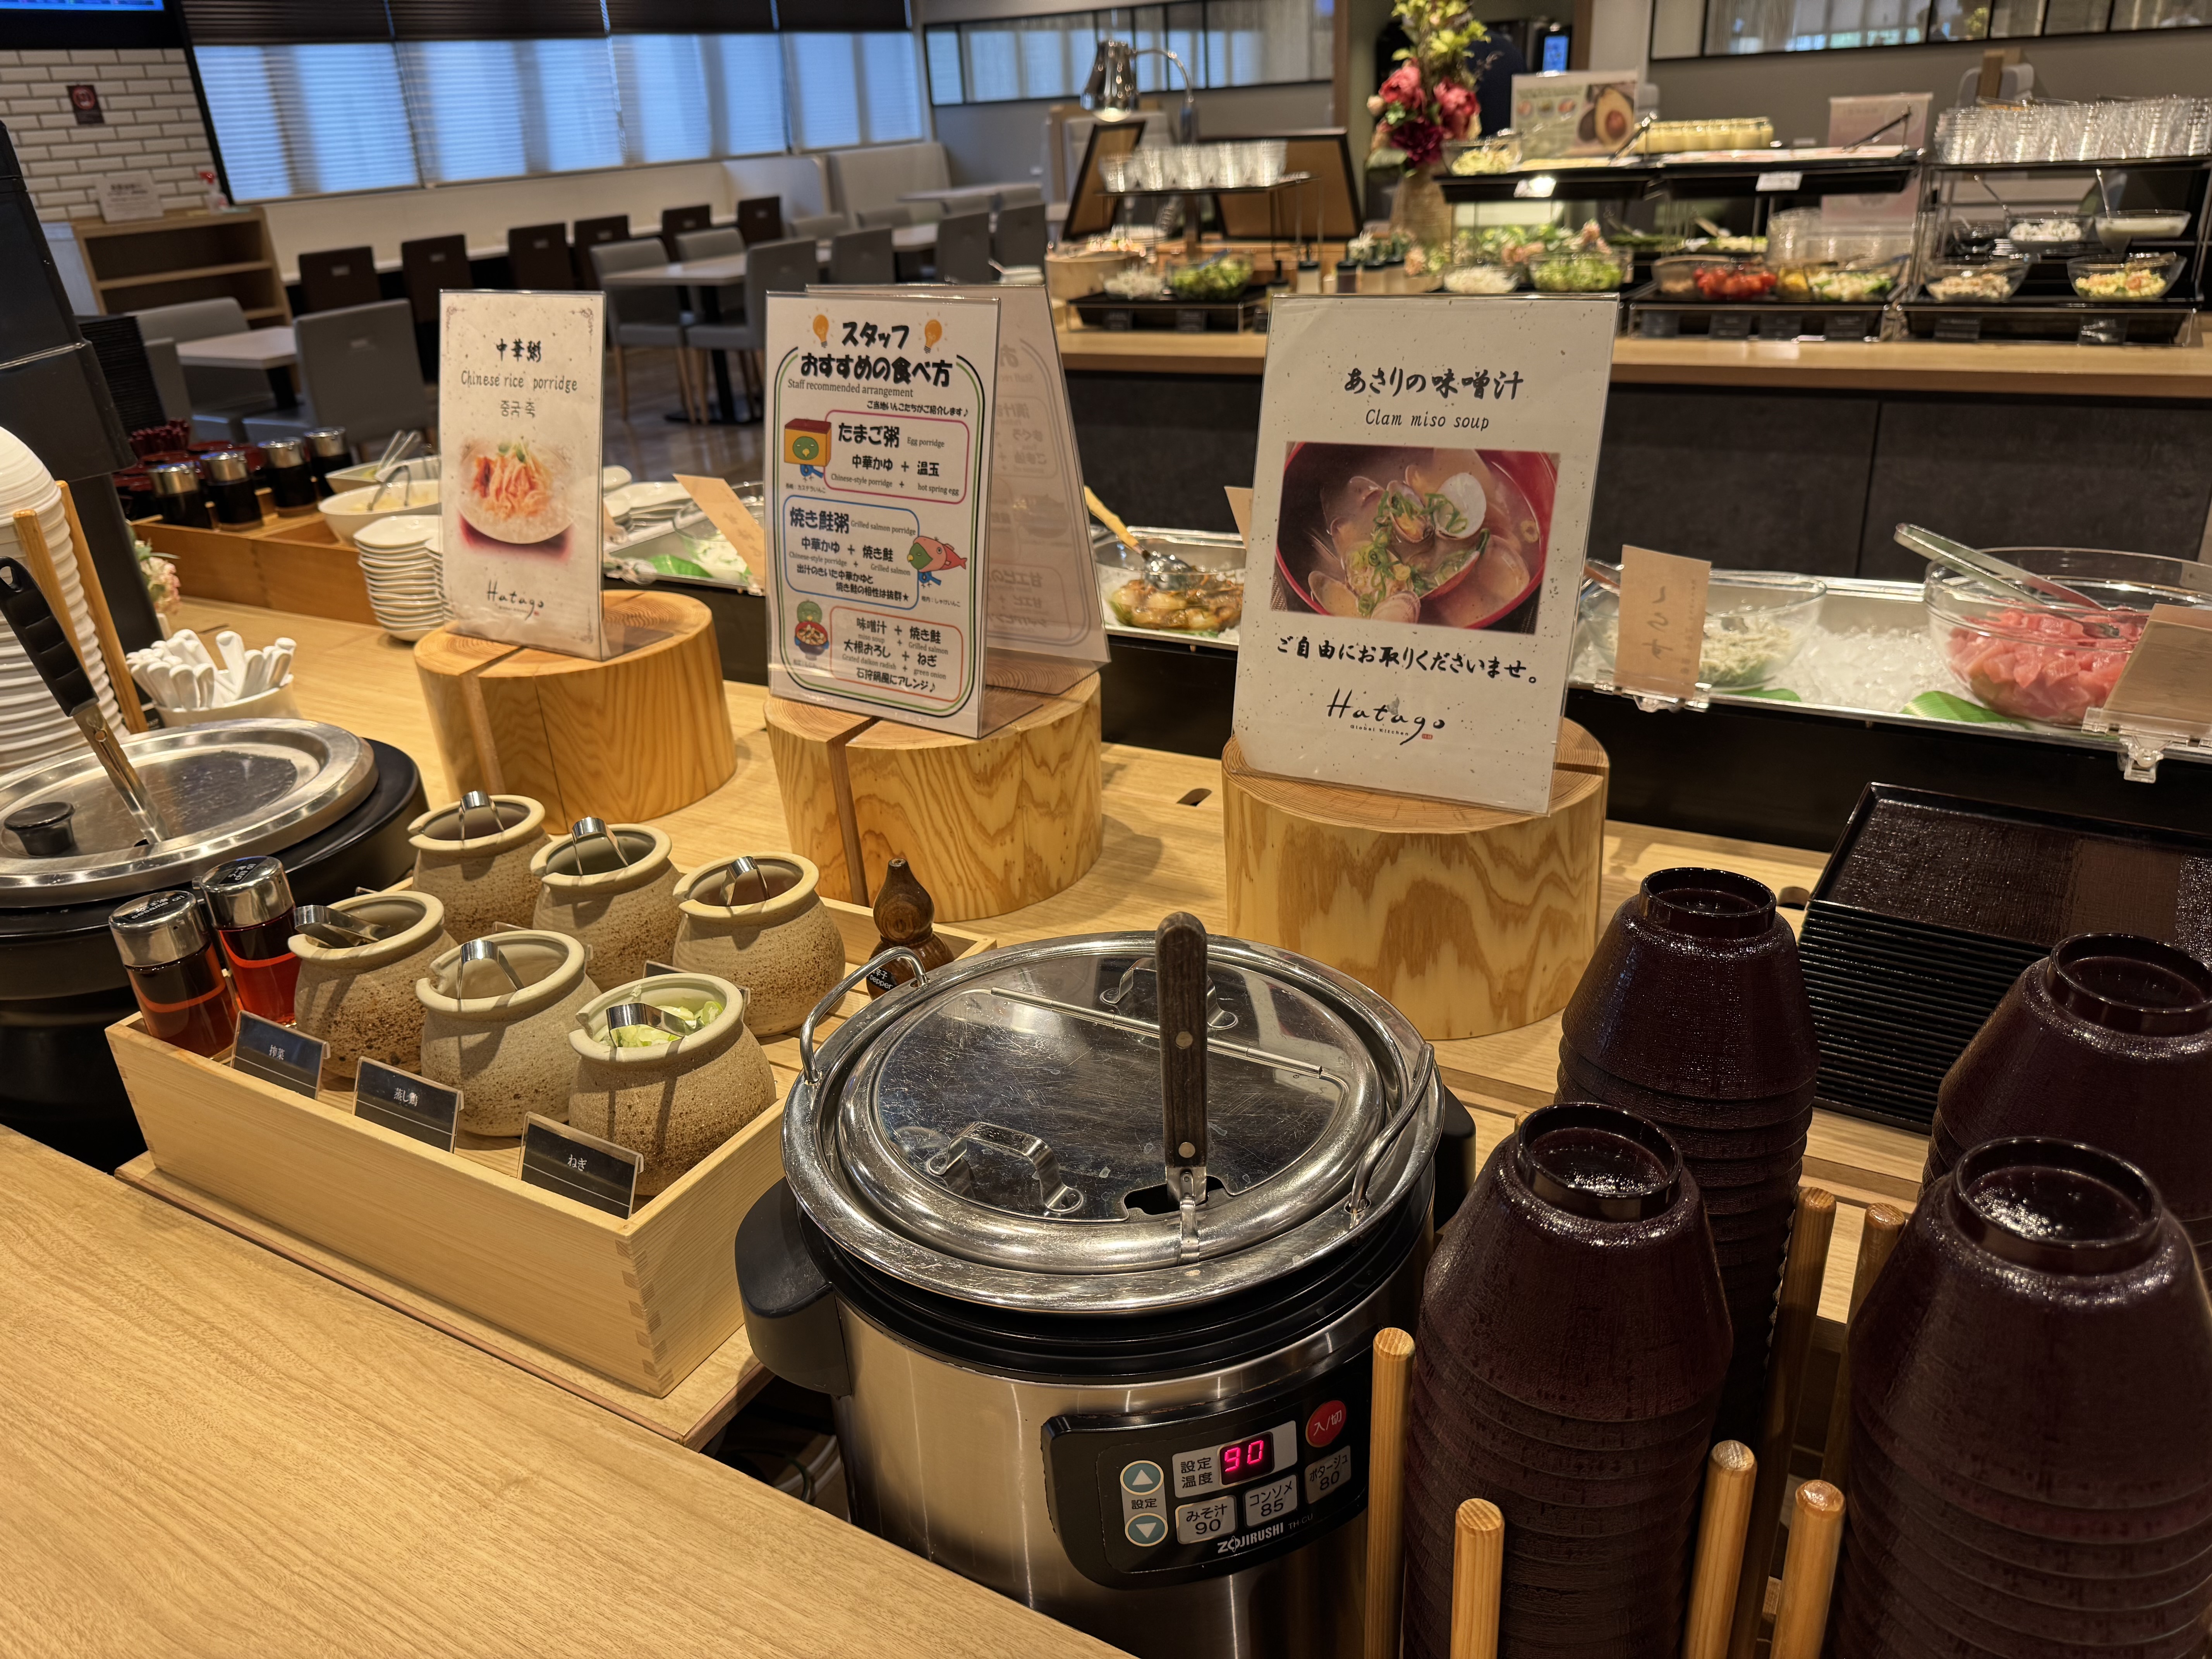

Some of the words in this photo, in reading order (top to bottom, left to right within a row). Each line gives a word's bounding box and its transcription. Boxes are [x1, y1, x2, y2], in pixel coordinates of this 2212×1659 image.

[842, 322, 909, 349] スタッフ
[495, 338, 541, 362] 中華粥
[801, 353, 953, 387] おすすめの食べ方
[461, 370, 500, 386] Chinese
[504, 373, 524, 388] rice
[533, 375, 578, 393] porridge
[788, 379, 805, 389] Staff
[806, 381, 860, 393] recommended
[862, 386, 913, 398] arrangement
[1344, 366, 1524, 400] あさりの味噌汁
[1365, 409, 1402, 425] Clam
[1411, 411, 1446, 427] miso
[1453, 416, 1489, 431] soup
[838, 422, 900, 448] たまご粥
[907, 437, 918, 446] Egg
[919, 438, 945, 448] porridge
[852, 454, 893, 471] 中華かゆ
[917, 461, 939, 477] 温玉
[831, 473, 867, 484] Chinese-style
[869, 477, 893, 488] porridge
[928, 484, 948, 495] spring
[790, 507, 849, 534] 焼き鮭粥
[851, 520, 869, 529] Grilled
[870, 523, 890, 532] salmon
[891, 526, 916, 536] porridge
[802, 536, 840, 554] 中華かゆ
[862, 545, 893, 562] 焼き鮭
[797, 564, 874, 584] 出汁のきいた中華かゆと
[824, 557, 847, 567] porridge
[871, 563, 890, 573] Grilled
[890, 567, 910, 576] salmon
[487, 579, 544, 621] Hatago
[857, 617, 887, 634] 味噌汁
[910, 626, 941, 644] 焼き鮭
[844, 639, 891, 658] 大根おろし
[917, 653, 937, 667] ねぎ
[872, 636, 885, 644] soup
[908, 642, 927, 651] Grilled
[928, 647, 948, 655] salmon
[860, 656, 879, 667] daikon
[879, 659, 896, 670] radish
[914, 668, 929, 677] green
[1277, 636, 1536, 684] ご自由にお取りくださいませ。
[1326, 688, 1445, 745] Hatago
[870, 974, 893, 989] pepper
[872, 968, 888, 979] 辛子
[567, 1154, 587, 1171] ねぎ
[1313, 1410, 1342, 1436] 入/切
[1180, 1457, 1212, 1474] 設定
[1224, 1440, 1264, 1472] 90
[1182, 1472, 1213, 1488] 温度
[1320, 1470, 1340, 1491] 80
[1131, 1498, 1157, 1510] 設定
[1250, 1480, 1292, 1506] コンソメ
[1186, 1504, 1228, 1522] みそ汁
[1261, 1498, 1284, 1517] 85
[1195, 1518, 1221, 1535] 90
[1217, 1522, 1284, 1554] ZOJIRUSHI
